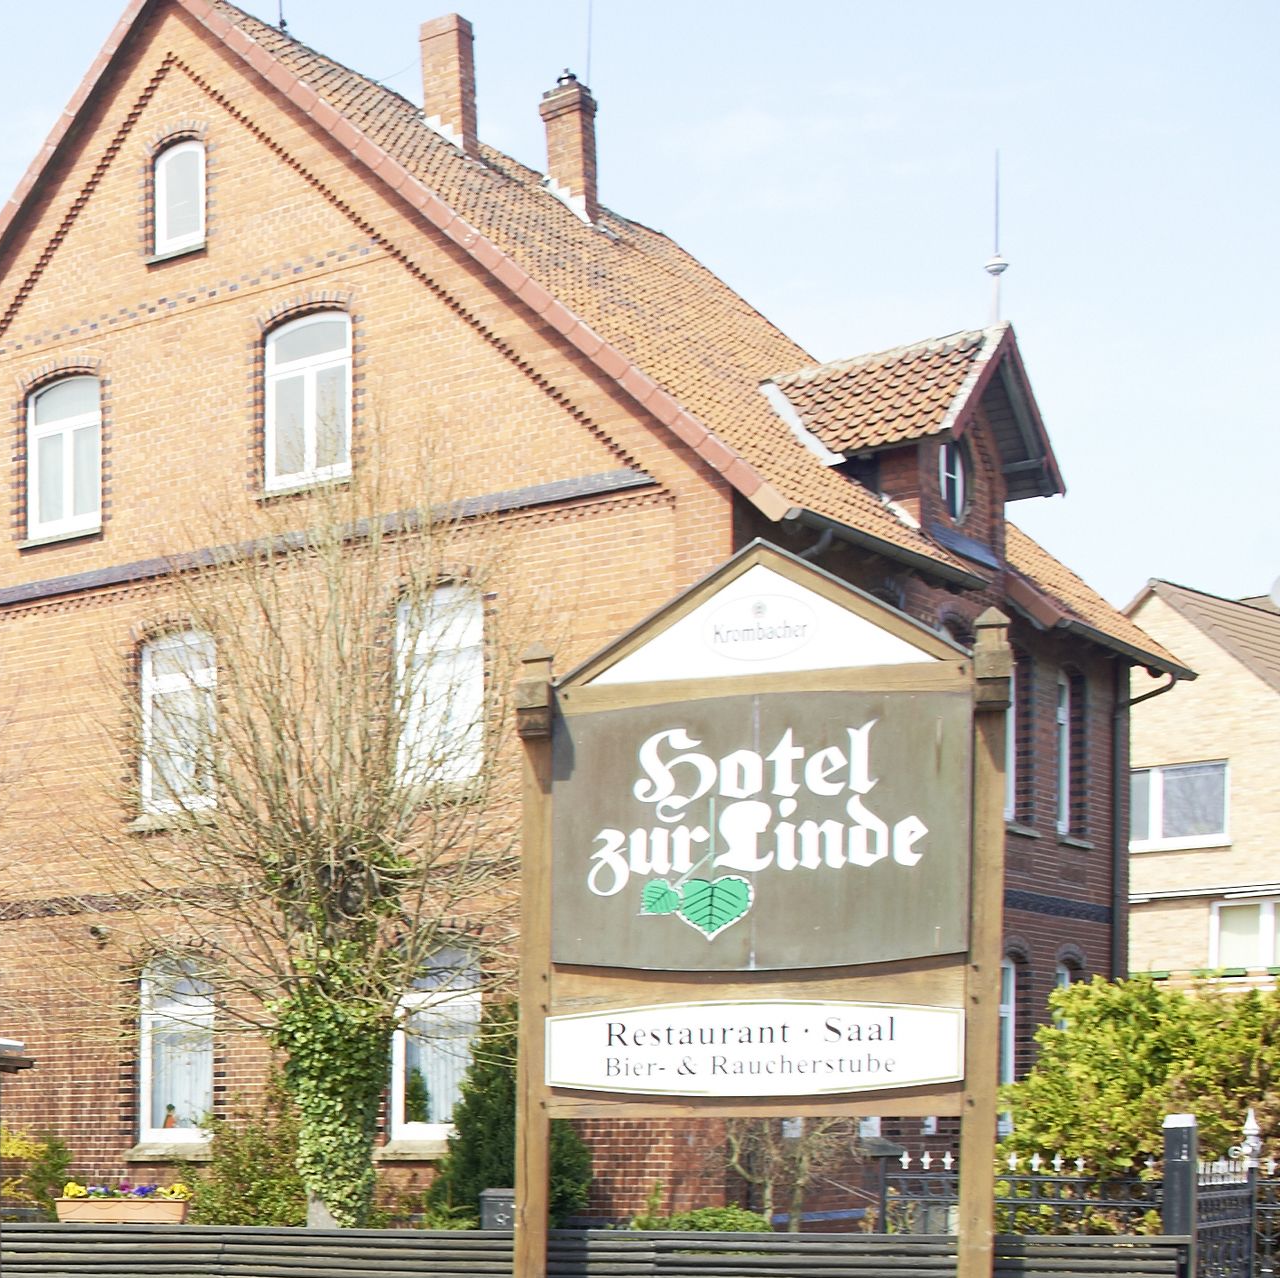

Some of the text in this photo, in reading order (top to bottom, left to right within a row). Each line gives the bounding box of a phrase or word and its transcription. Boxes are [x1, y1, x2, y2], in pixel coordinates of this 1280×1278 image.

[713, 620, 808, 644] Krombacher
[632, 718, 880, 822] Hotel
[587, 795, 930, 897] zur Linde
[606, 1022, 790, 1047] Restaurant
[823, 1016, 896, 1043] Saal
[605, 1052, 896, 1078] Bier- & Raucherstube
